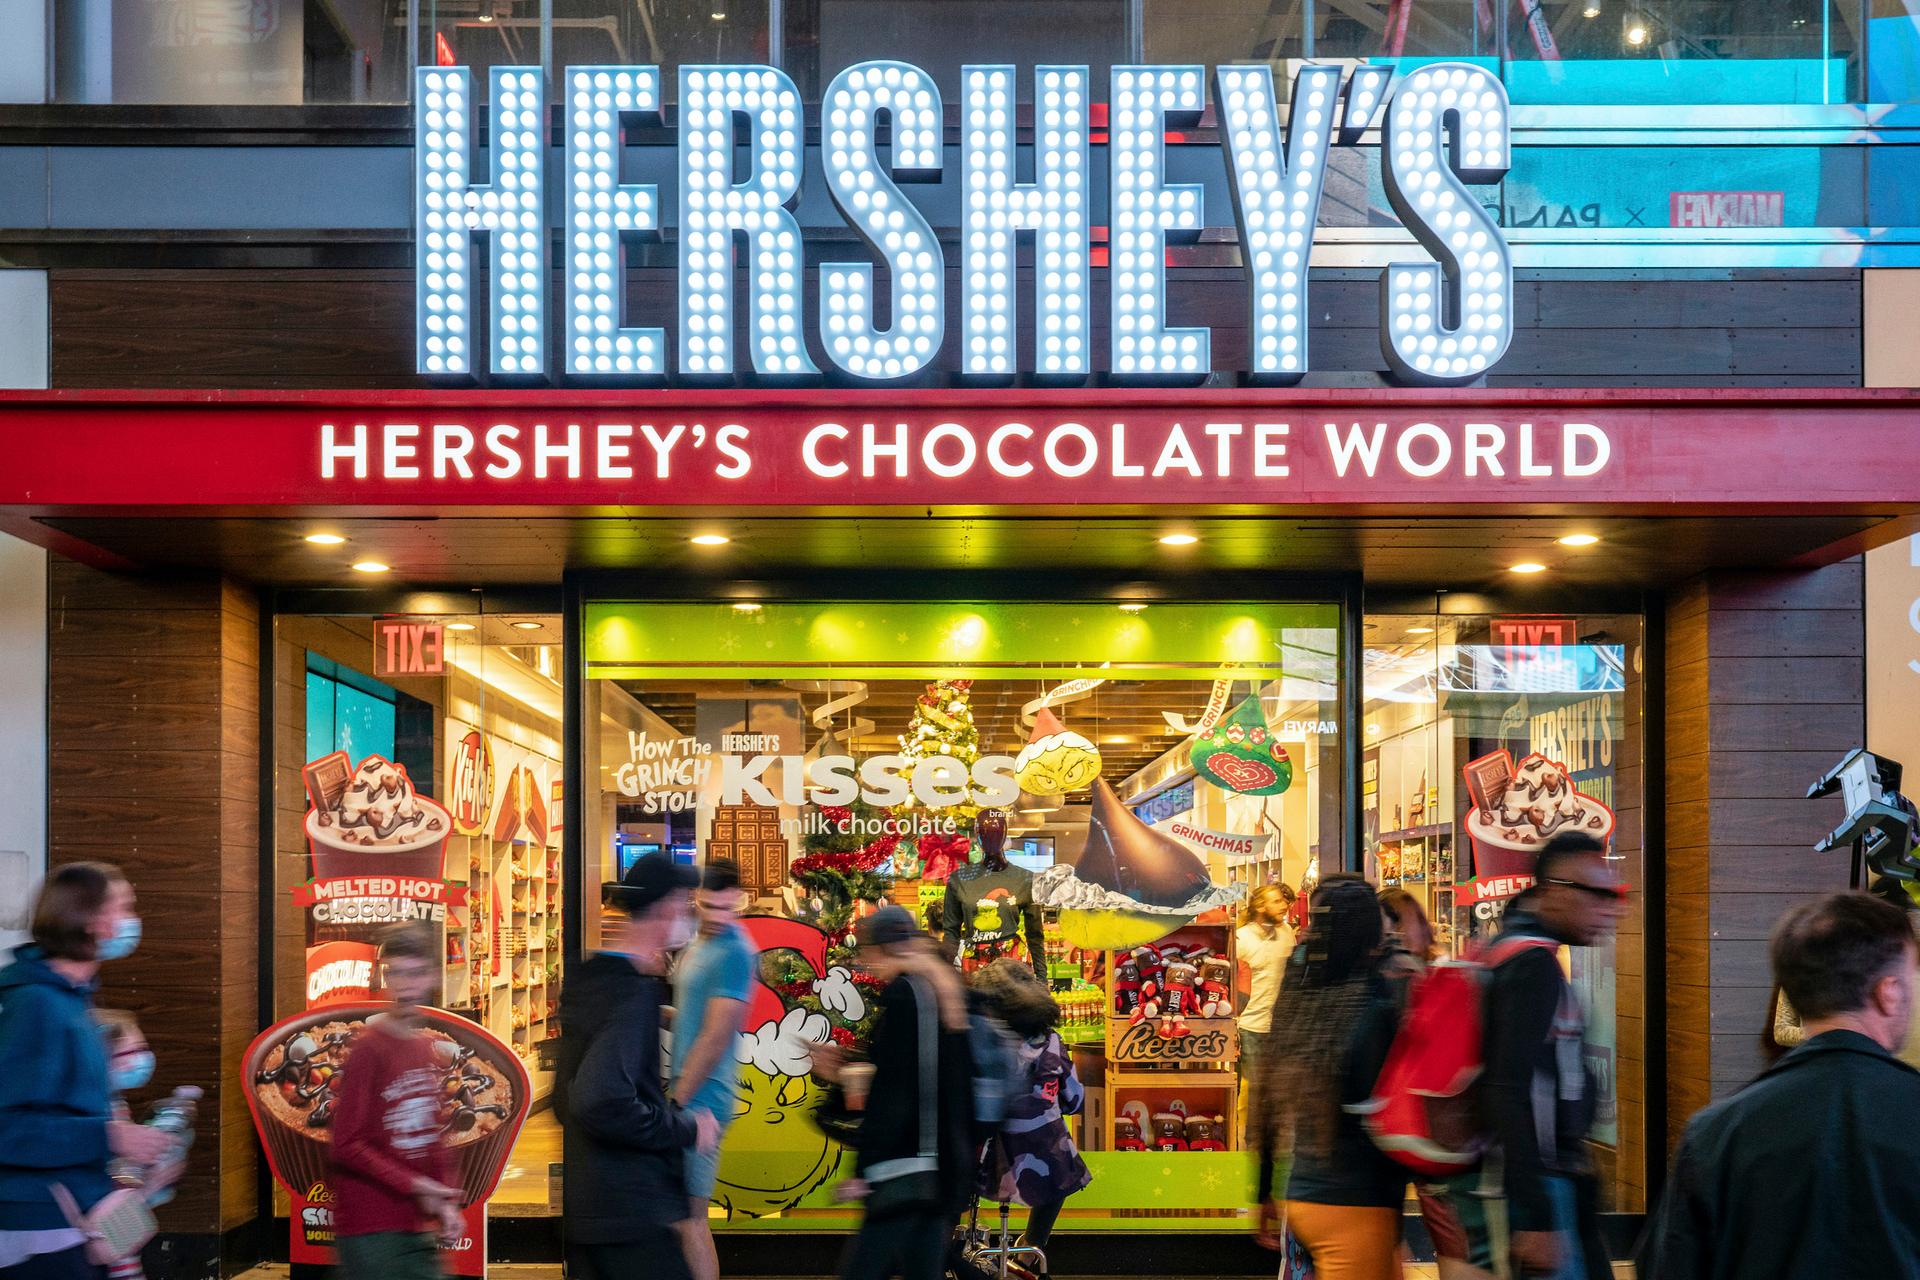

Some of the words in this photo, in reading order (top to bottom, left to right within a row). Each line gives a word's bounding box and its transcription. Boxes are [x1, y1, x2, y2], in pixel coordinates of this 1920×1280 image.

[415, 60, 1514, 380] HERSHEY'S
[320, 424, 752, 479] HERSHEY'S
[801, 423, 1290, 478] CHOCOLATE
[1324, 423, 1611, 478] WORLD
[722, 734, 780, 752] HERSHEY'S
[616, 757, 712, 798] GRINCH
[643, 790, 706, 815] STOL
[780, 813, 831, 836] milk
[837, 813, 956, 836] chocolate
[1171, 823, 1253, 854] GRINCHMAS
[313, 878, 397, 900] MELTED
[399, 879, 445, 900] HOT
[312, 901, 446, 922] CHOCOLATE
[1115, 1021, 1229, 1060] Reese's
